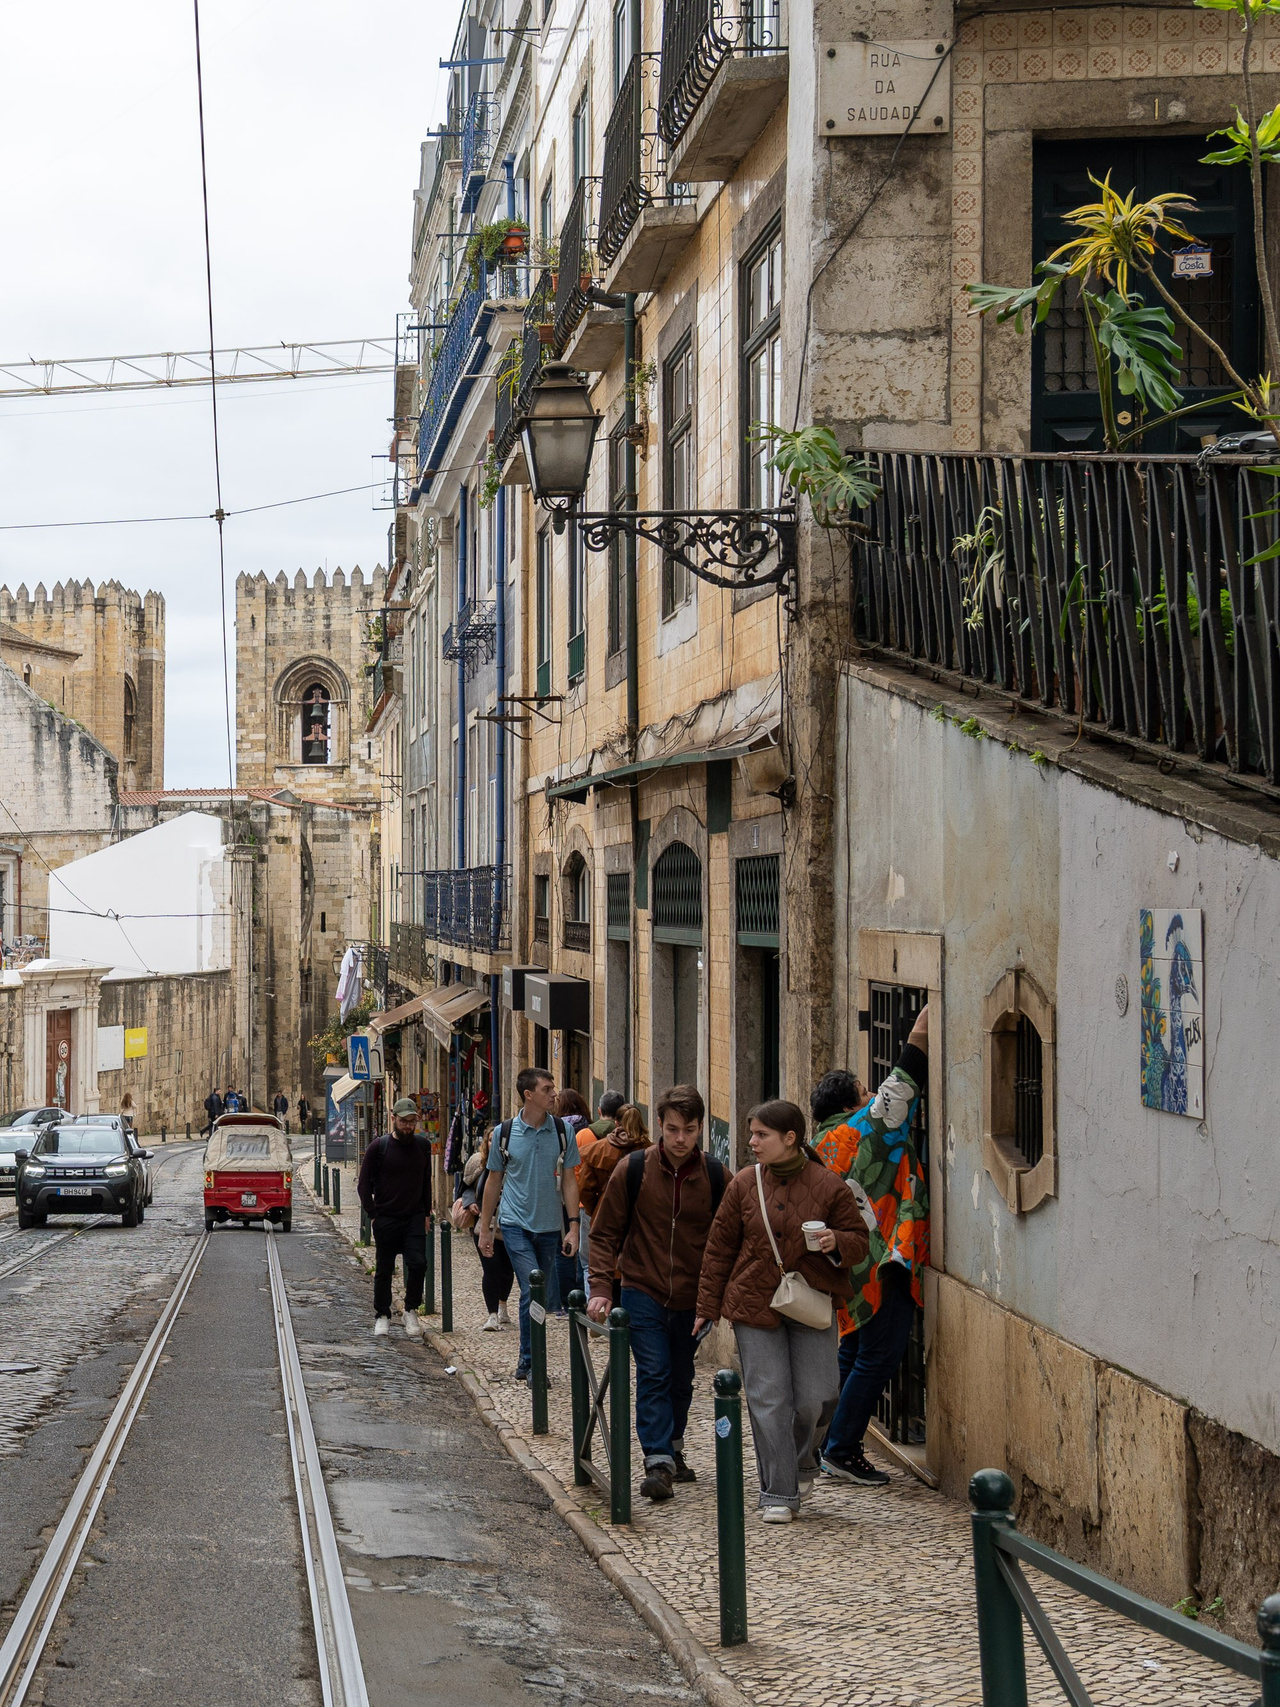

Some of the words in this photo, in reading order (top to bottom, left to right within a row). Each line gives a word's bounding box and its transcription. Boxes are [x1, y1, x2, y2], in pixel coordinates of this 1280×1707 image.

[870, 53, 901, 68] RUA
[875, 80, 896, 94] DA
[847, 106, 922, 121] SAUDADE
[1179, 261, 1205, 271] Costa
